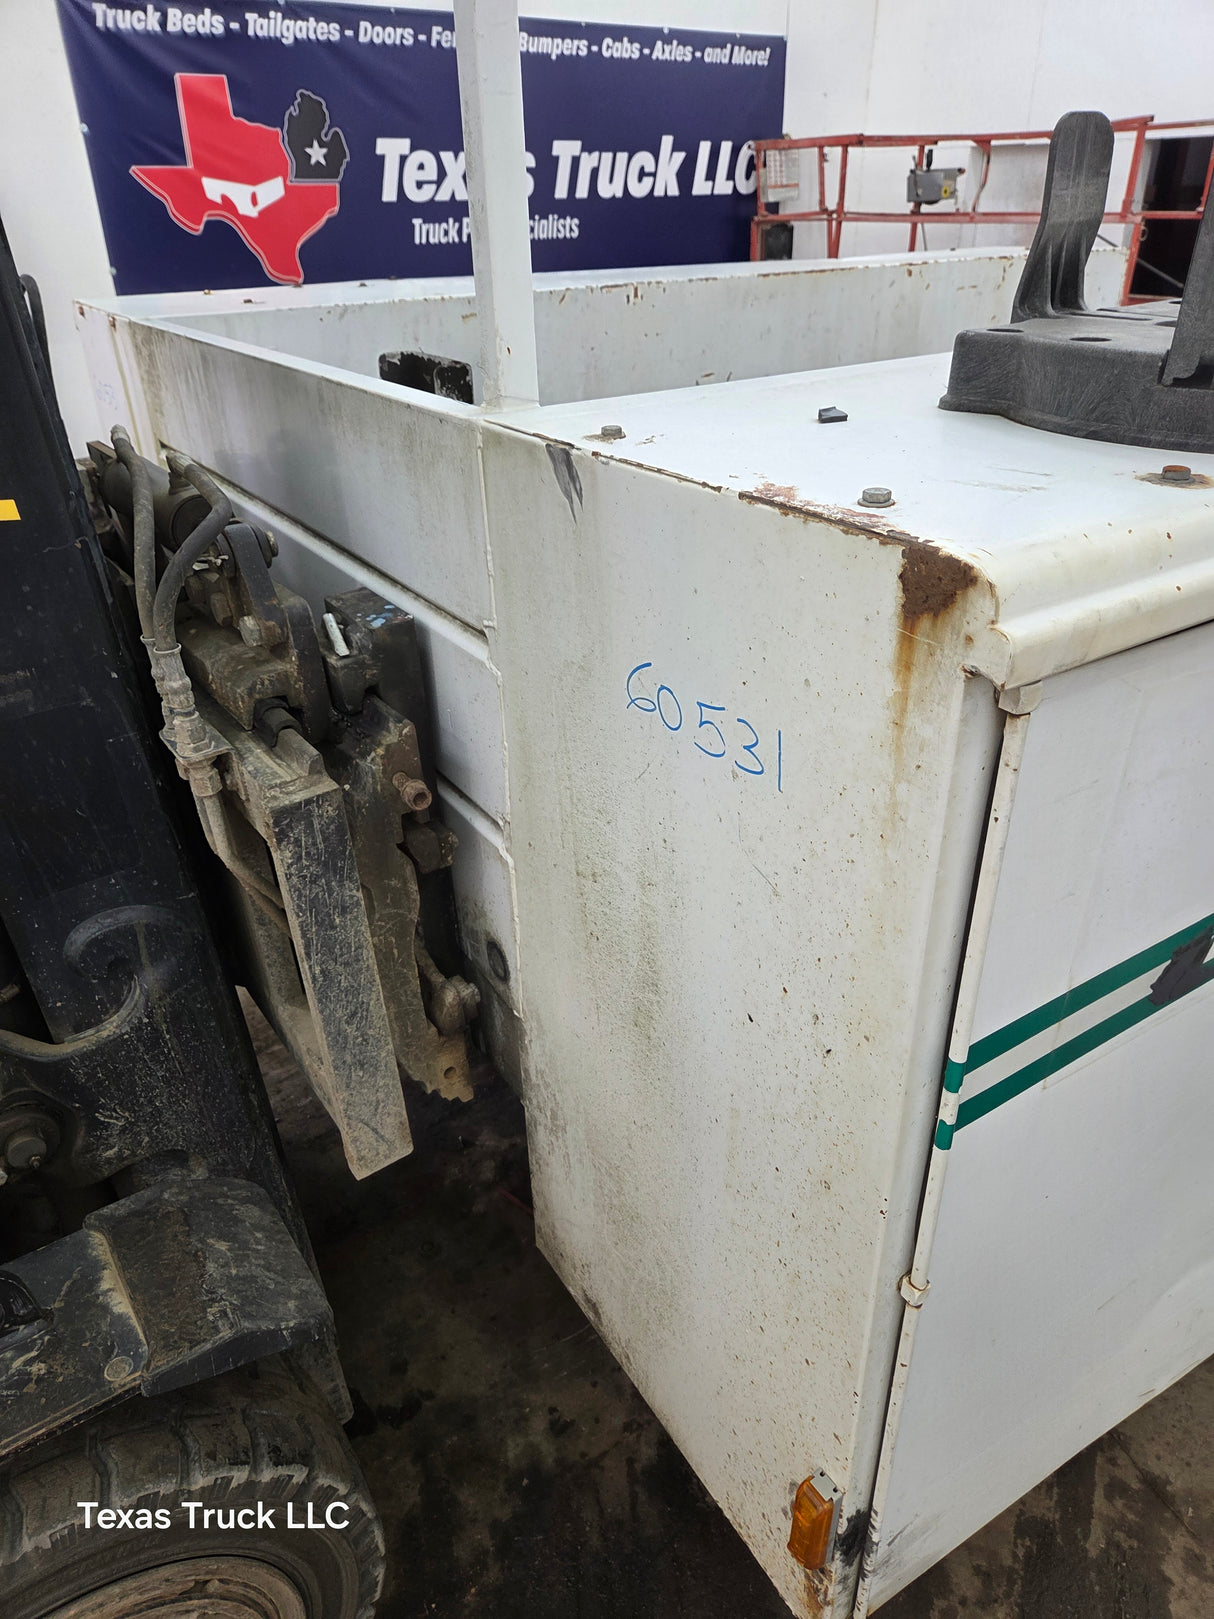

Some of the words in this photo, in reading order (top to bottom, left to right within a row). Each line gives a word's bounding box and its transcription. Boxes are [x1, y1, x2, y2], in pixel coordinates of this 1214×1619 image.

[92, 3, 162, 33] Truck
[166, 8, 225, 37] Beds
[245, 11, 340, 45] Tailgates
[358, 20, 414, 46] Doors
[519, 31, 589, 61] Bumpers
[601, 36, 640, 59] Cabs
[652, 40, 693, 62] Axles
[703, 43, 732, 65] and
[731, 45, 771, 67] More!
[552, 134, 687, 199] Truck
[692, 140, 758, 196] LLC
[412, 217, 460, 245] Truck
[627, 662, 783, 792] 60531
